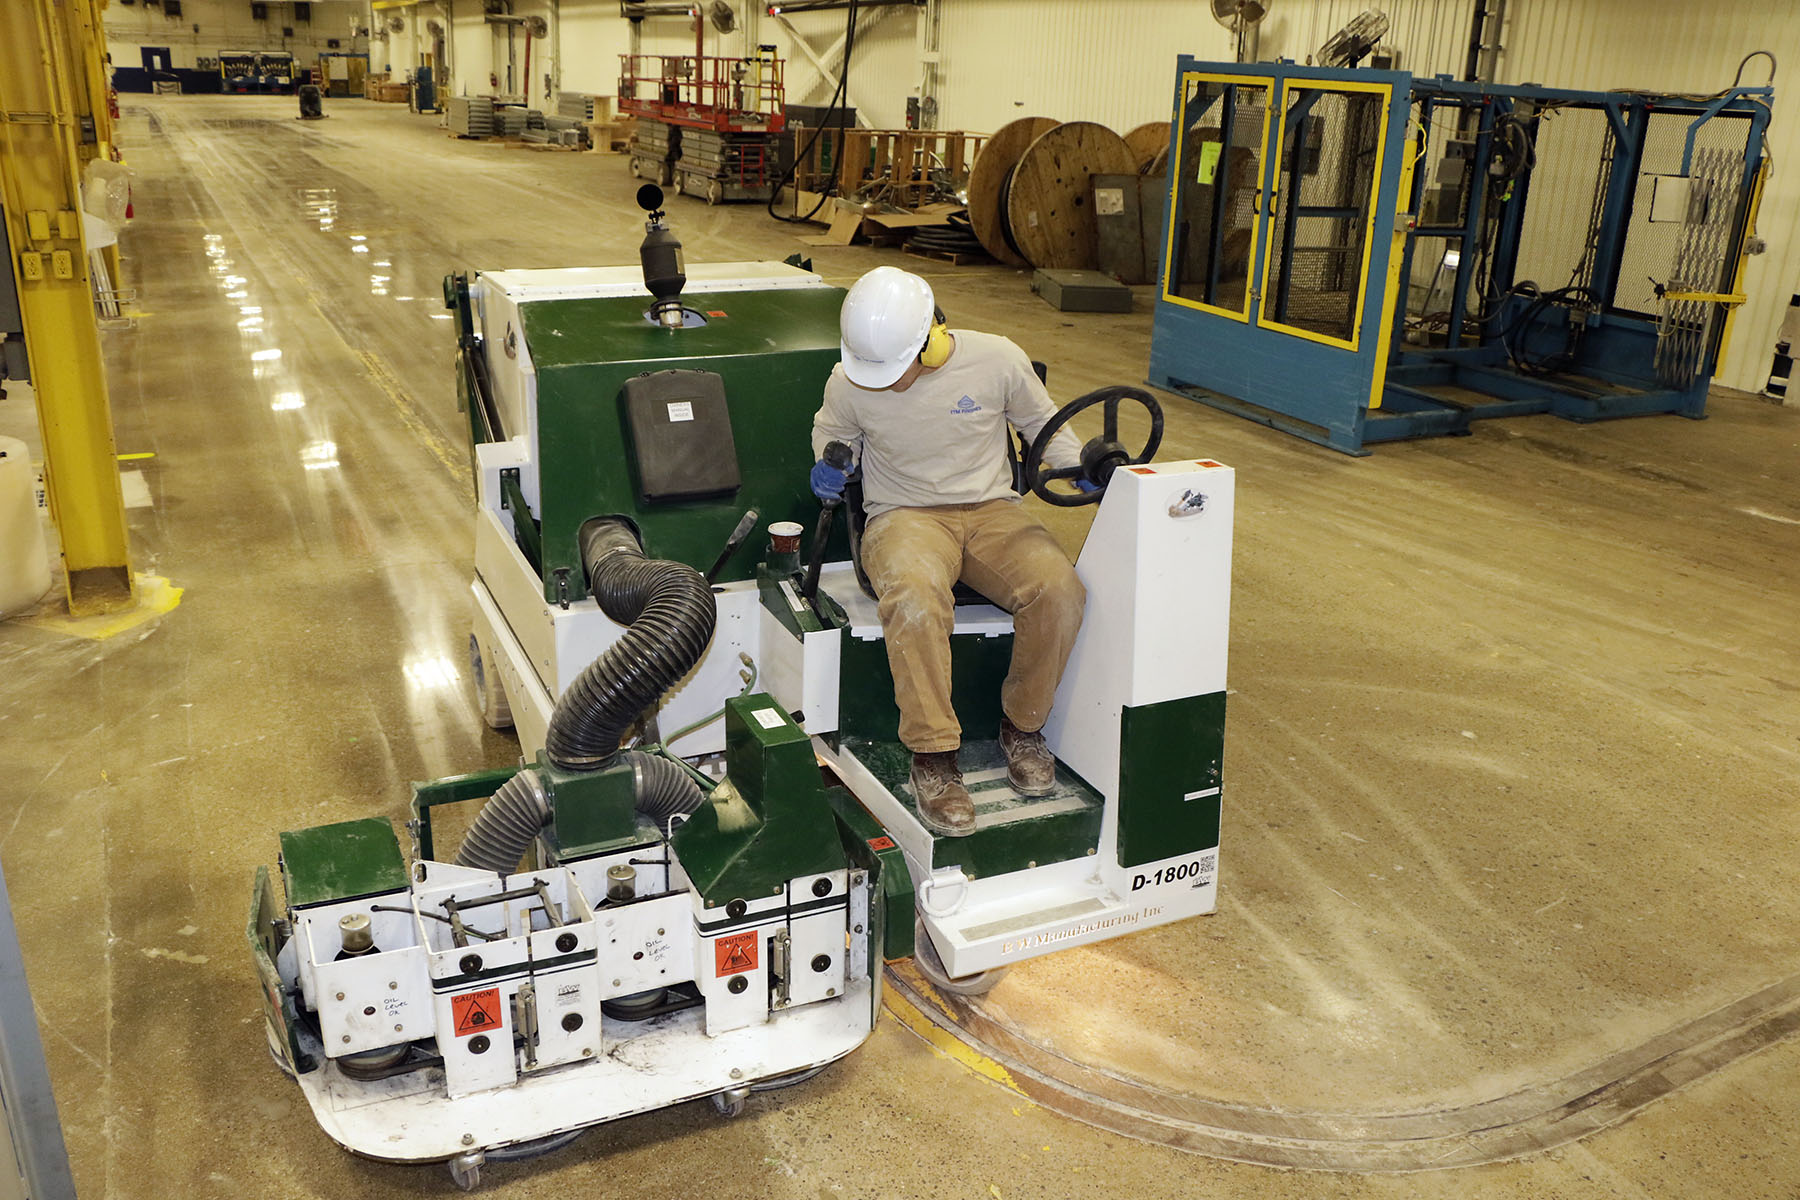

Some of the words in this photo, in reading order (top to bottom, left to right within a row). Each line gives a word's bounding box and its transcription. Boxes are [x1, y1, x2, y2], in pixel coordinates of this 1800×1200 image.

[1132, 861, 1200, 891] D-1800
[718, 933, 754, 946] CAUTION!
[1033, 911, 1140, 946] Manufacturing
[454, 990, 494, 1004] CAUTION!
